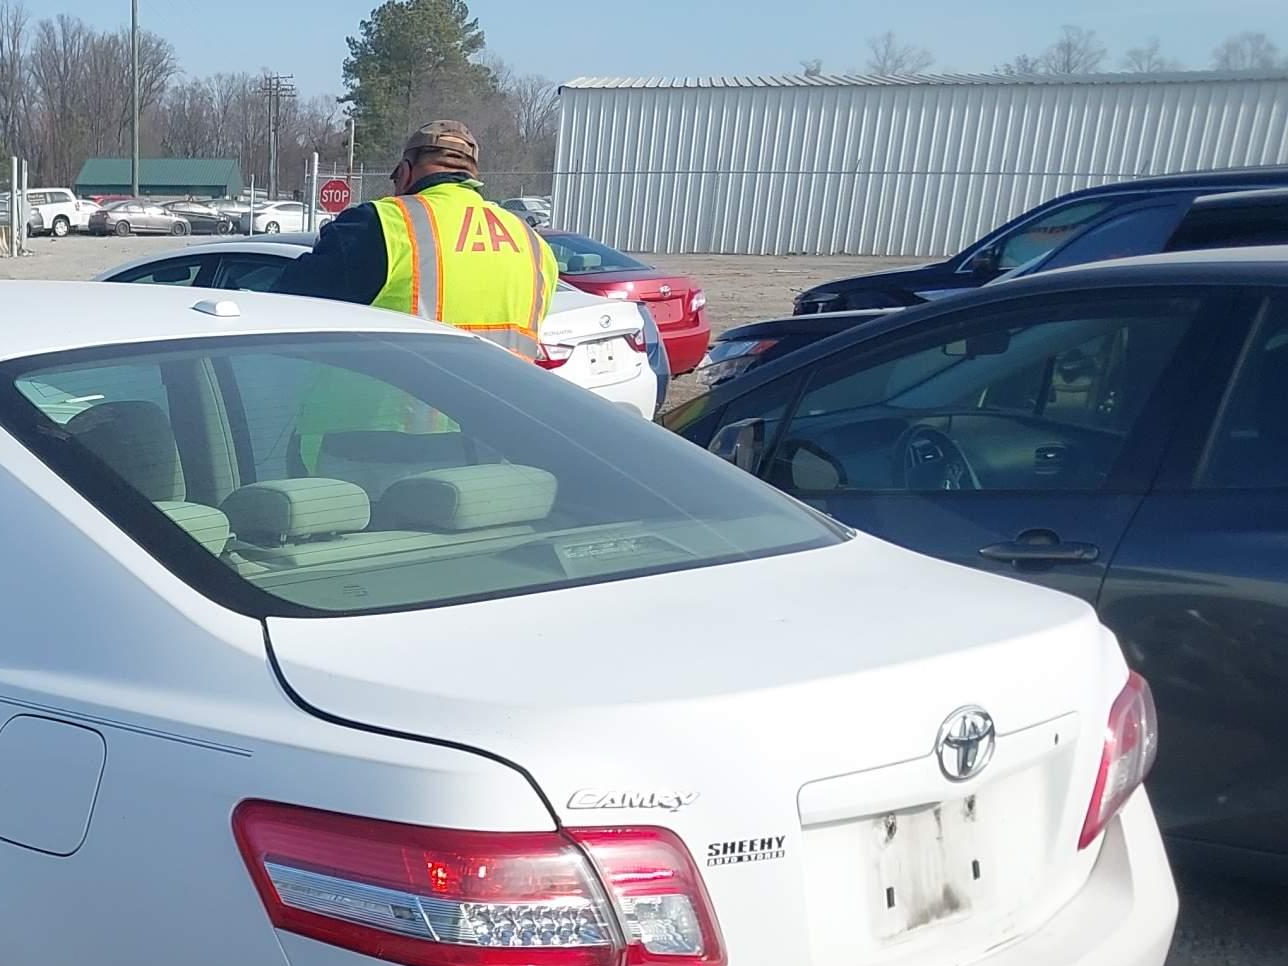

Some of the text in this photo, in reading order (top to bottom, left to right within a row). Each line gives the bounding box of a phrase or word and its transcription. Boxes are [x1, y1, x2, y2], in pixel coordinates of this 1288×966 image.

[322, 190, 349, 202] STOP
[566, 788, 700, 812] CAMRY
[707, 835, 785, 856] SHEEHY
[707, 855, 739, 866] AUTO
